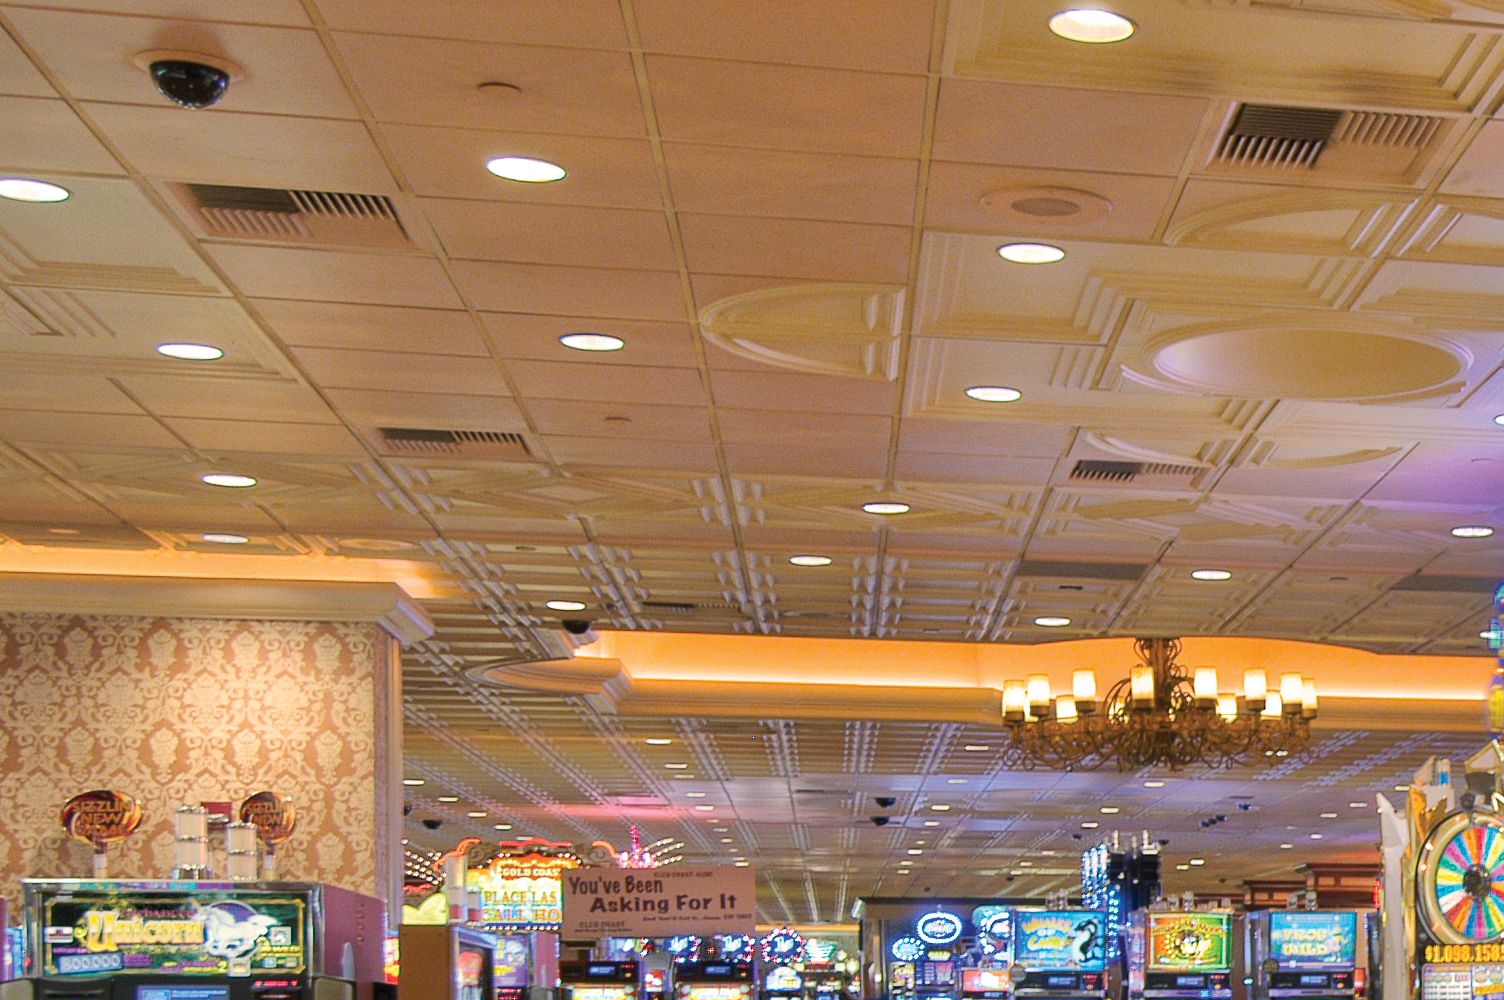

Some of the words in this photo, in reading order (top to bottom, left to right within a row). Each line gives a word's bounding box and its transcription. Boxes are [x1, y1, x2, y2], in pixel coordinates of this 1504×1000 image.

[81, 812, 122, 825] NEW
[569, 876, 620, 895] You've
[625, 876, 663, 893] Been
[590, 897, 669, 913] Asking
[677, 895, 712, 910] For
[721, 894, 736, 909] It
[87, 911, 204, 951] Unicorn
